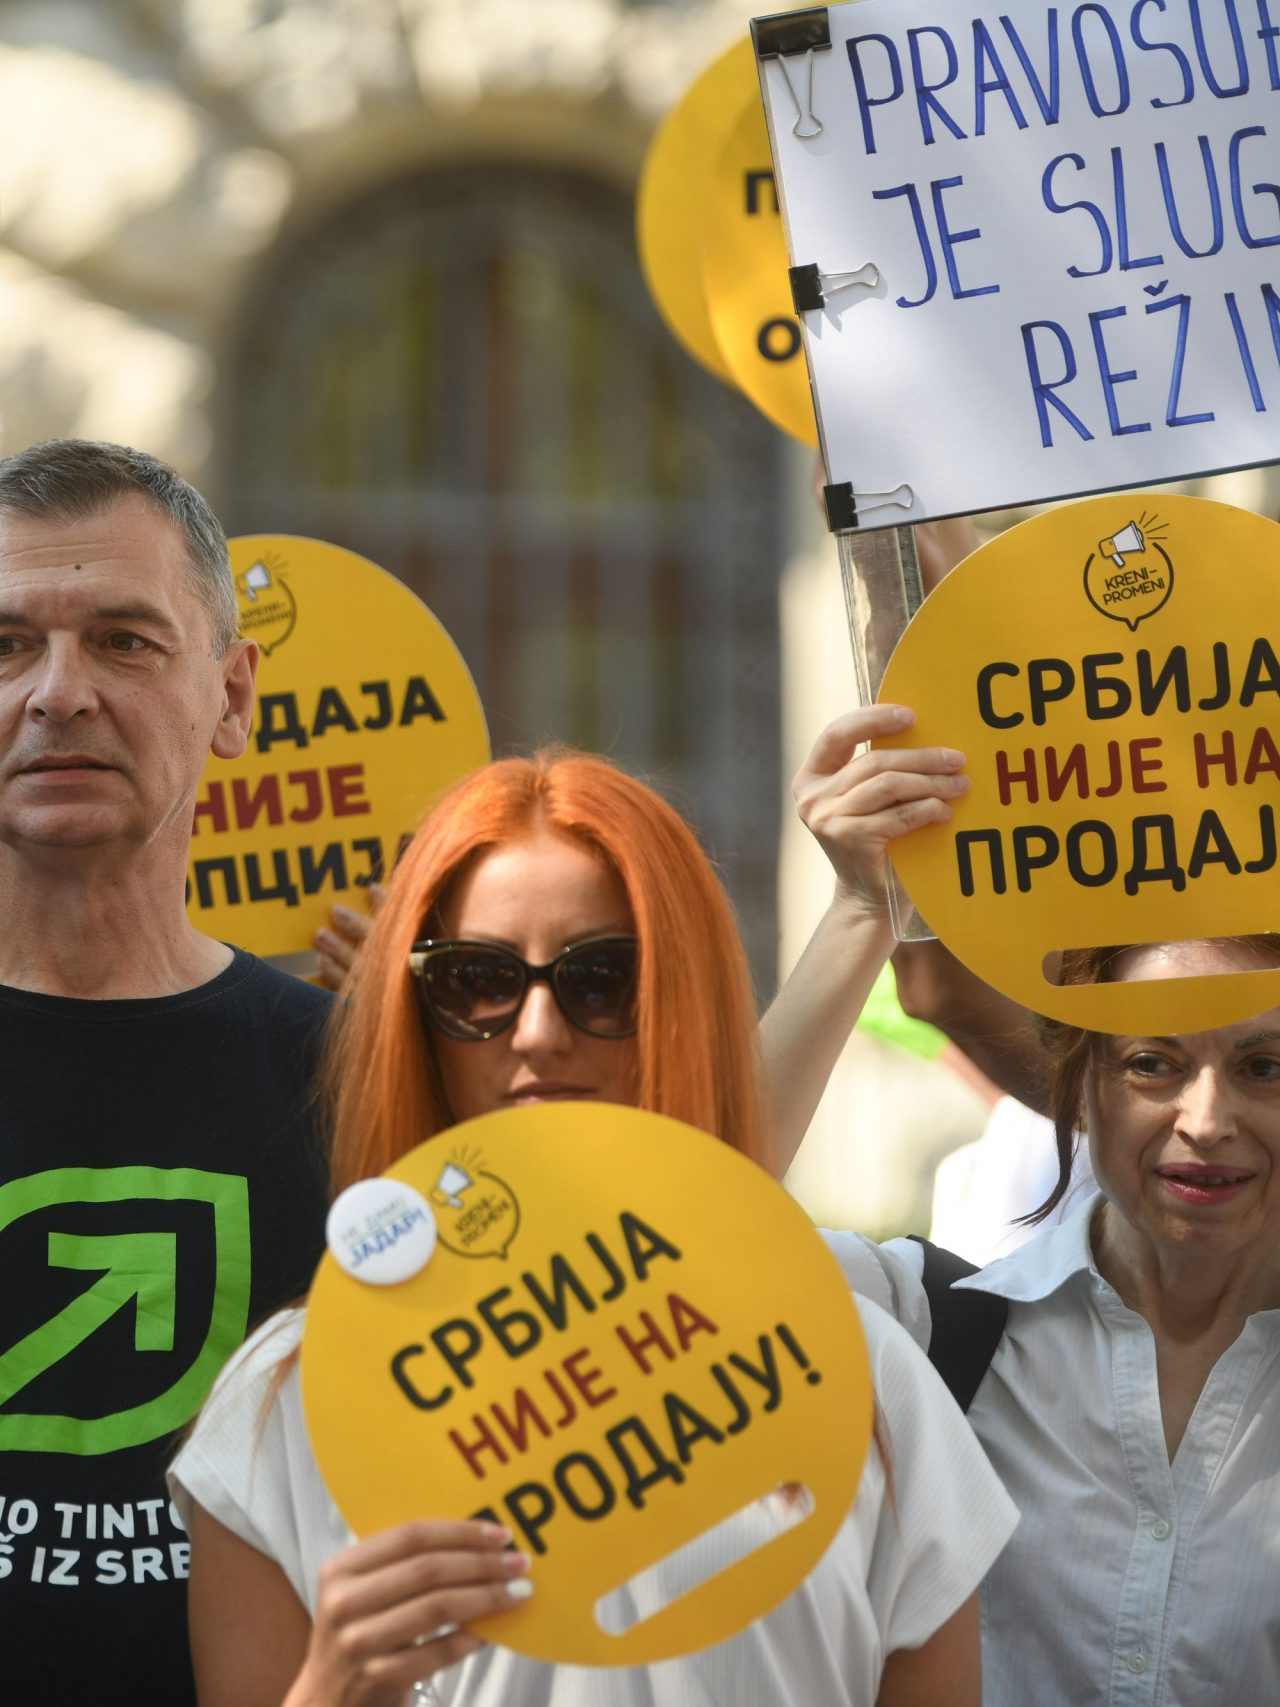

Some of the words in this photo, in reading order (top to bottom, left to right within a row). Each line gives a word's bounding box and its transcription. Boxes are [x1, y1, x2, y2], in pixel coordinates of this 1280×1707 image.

[872, 176, 1000, 308] JE
[1042, 126, 1280, 278] SLUG
[1102, 577, 1166, 606] PROMENI
[1104, 567, 1158, 592] KRENI-
[248, 675, 447, 754] ДАЈА
[976, 637, 1280, 730] СРБИЈА
[996, 736, 1168, 806] НИЈЕ
[1193, 727, 1280, 789] НА
[185, 833, 418, 911] ПЦИЈ
[955, 804, 1278, 897] ПРОДАЈ
[390, 1210, 682, 1412] СРБИЈА
[448, 1347, 618, 1480] НИЈЕ
[615, 1292, 719, 1376] НА
[31, 1546, 80, 1586] IZ
